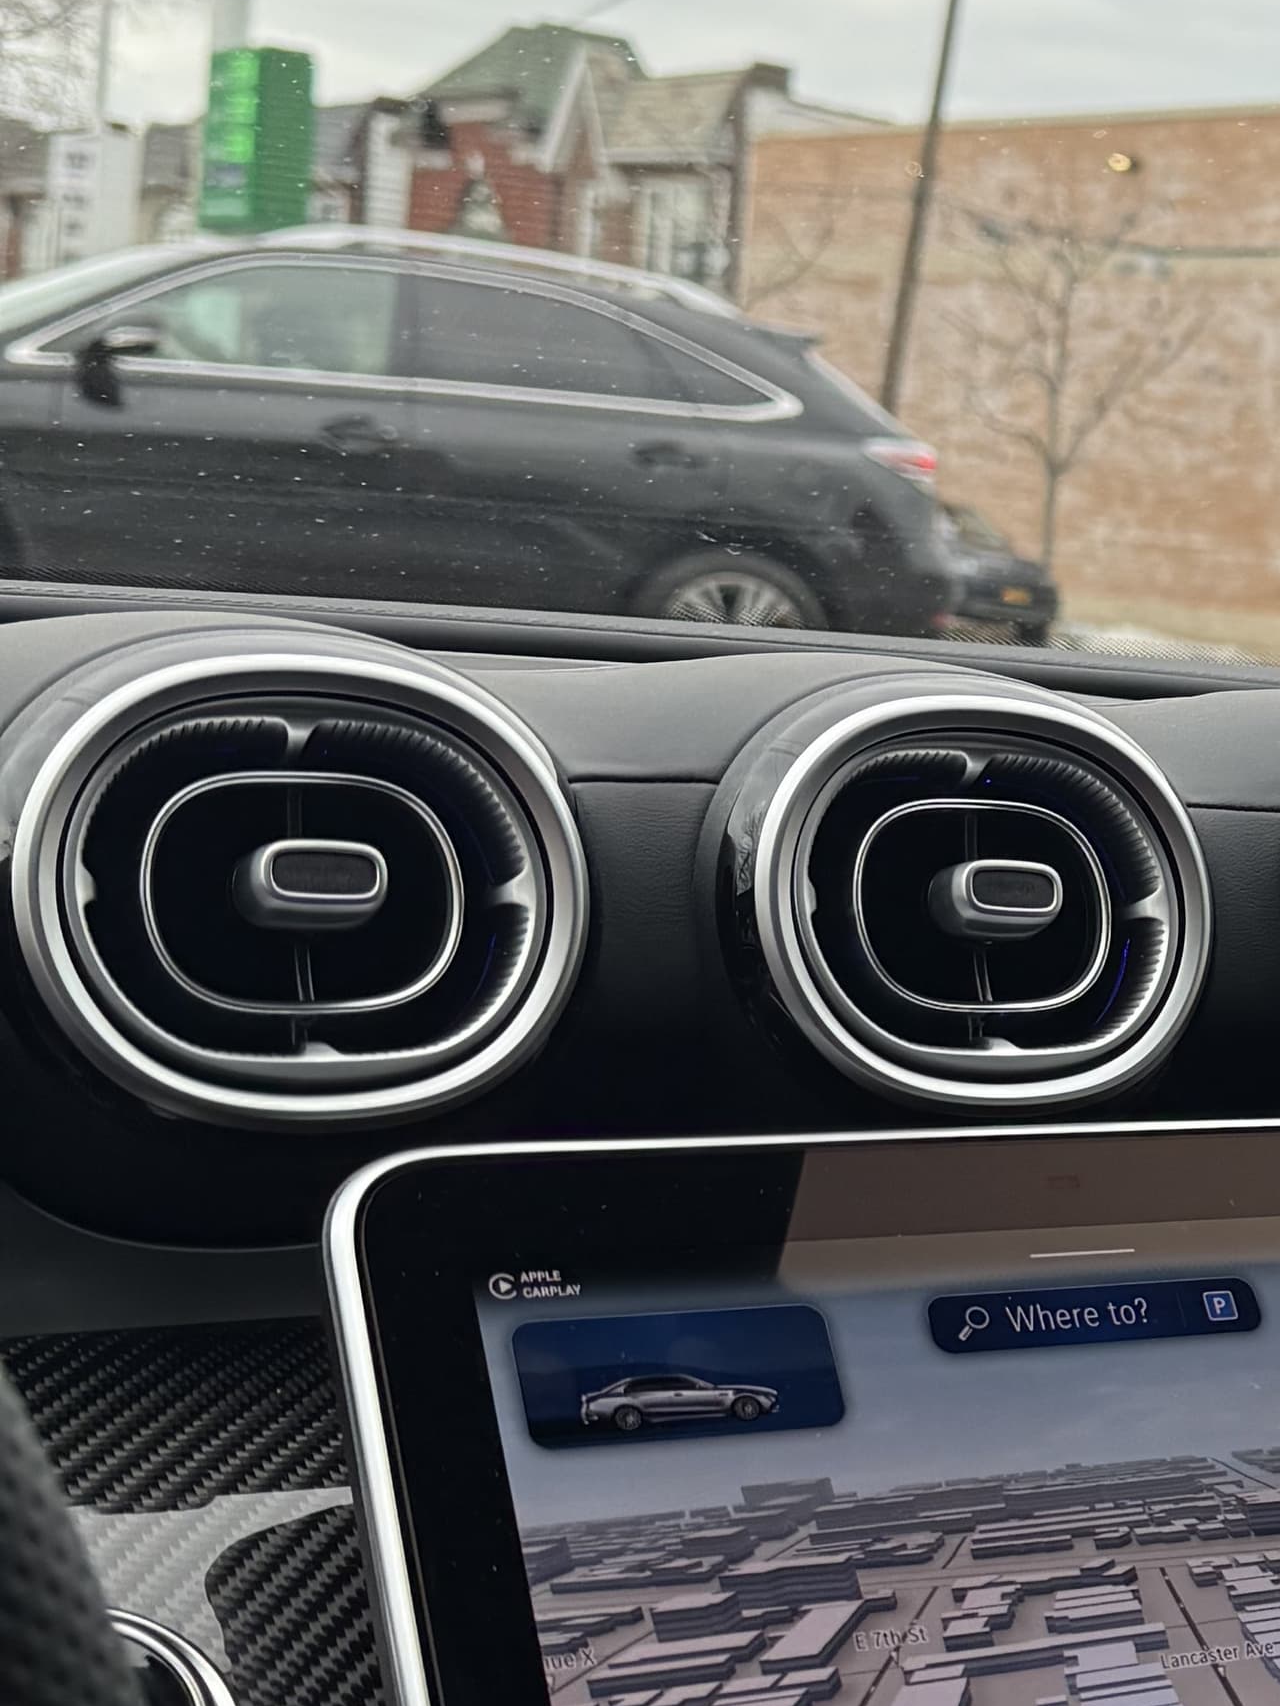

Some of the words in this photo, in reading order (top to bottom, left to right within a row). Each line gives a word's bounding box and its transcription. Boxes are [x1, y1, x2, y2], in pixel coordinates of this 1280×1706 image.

[520, 1270, 561, 1283] APPLE
[523, 1284, 581, 1298] CARPLAY
[1006, 1302, 1100, 1335] Where
[1106, 1298, 1149, 1327] to?
[855, 1634, 866, 1650] E
[872, 1630, 901, 1647] 7th
[907, 1624, 928, 1643] St
[582, 1648, 595, 1666] X
[1160, 1645, 1240, 1668] Lancaster
[1246, 1640, 1275, 1659] Ave
